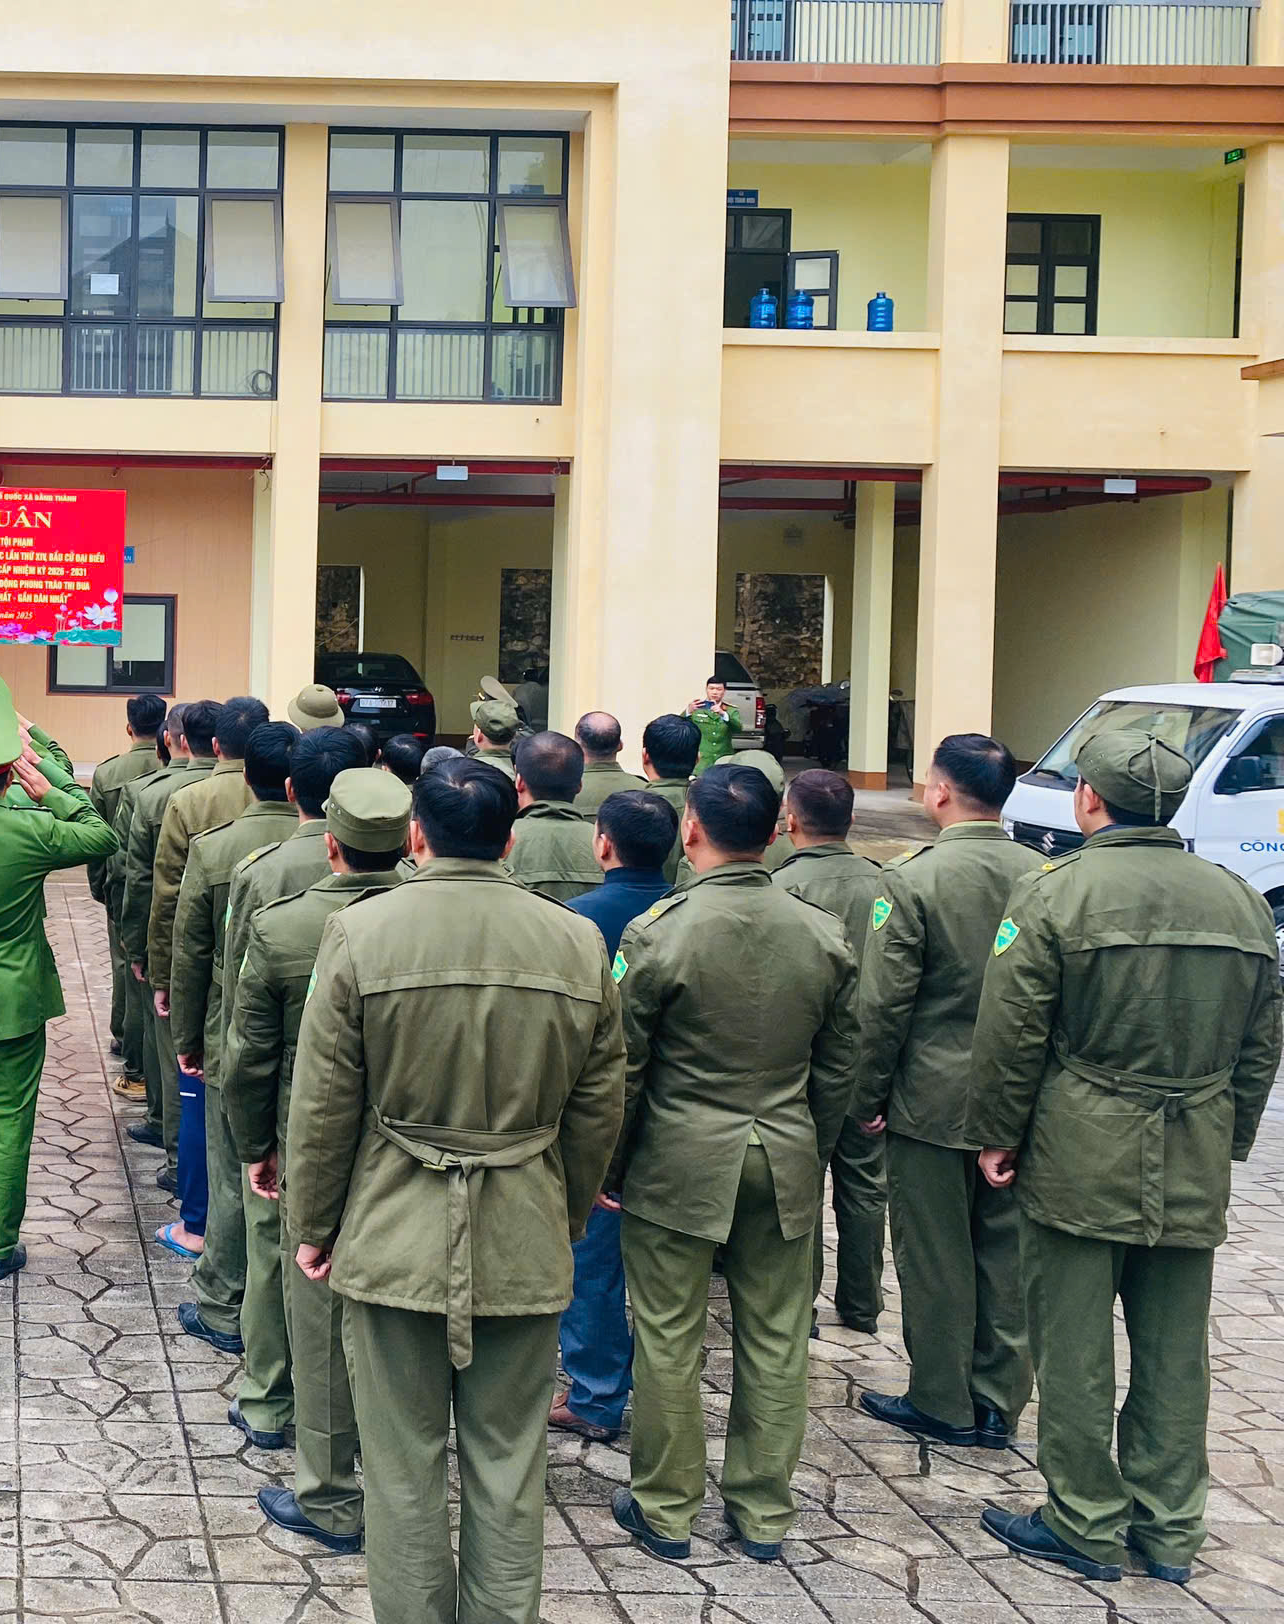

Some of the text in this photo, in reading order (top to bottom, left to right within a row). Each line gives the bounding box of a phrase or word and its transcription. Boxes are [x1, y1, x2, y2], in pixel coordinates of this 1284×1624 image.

[0, 536, 12, 547] TỘI
[12, 538, 34, 548] PHẠM
[6, 550, 20, 560] LẦN
[20, 550, 34, 561] THỨ
[48, 551, 64, 561] BẦU
[64, 551, 74, 562] CỬ
[74, 553, 88, 563] ĐẠI
[88, 552, 104, 562] BIỂU
[12, 565, 36, 577] NHIỆM
[36, 565, 46, 576] KỲ
[48, 568, 64, 576] 2026
[70, 568, 86, 577] 2031
[20, 580, 44, 589] PHONG
[44, 579, 62, 589] TRÀO
[62, 581, 76, 590] THI
[76, 582, 90, 590] ĐUA
[18, 592, 32, 602] GẦN
[32, 592, 48, 603] DÂN
